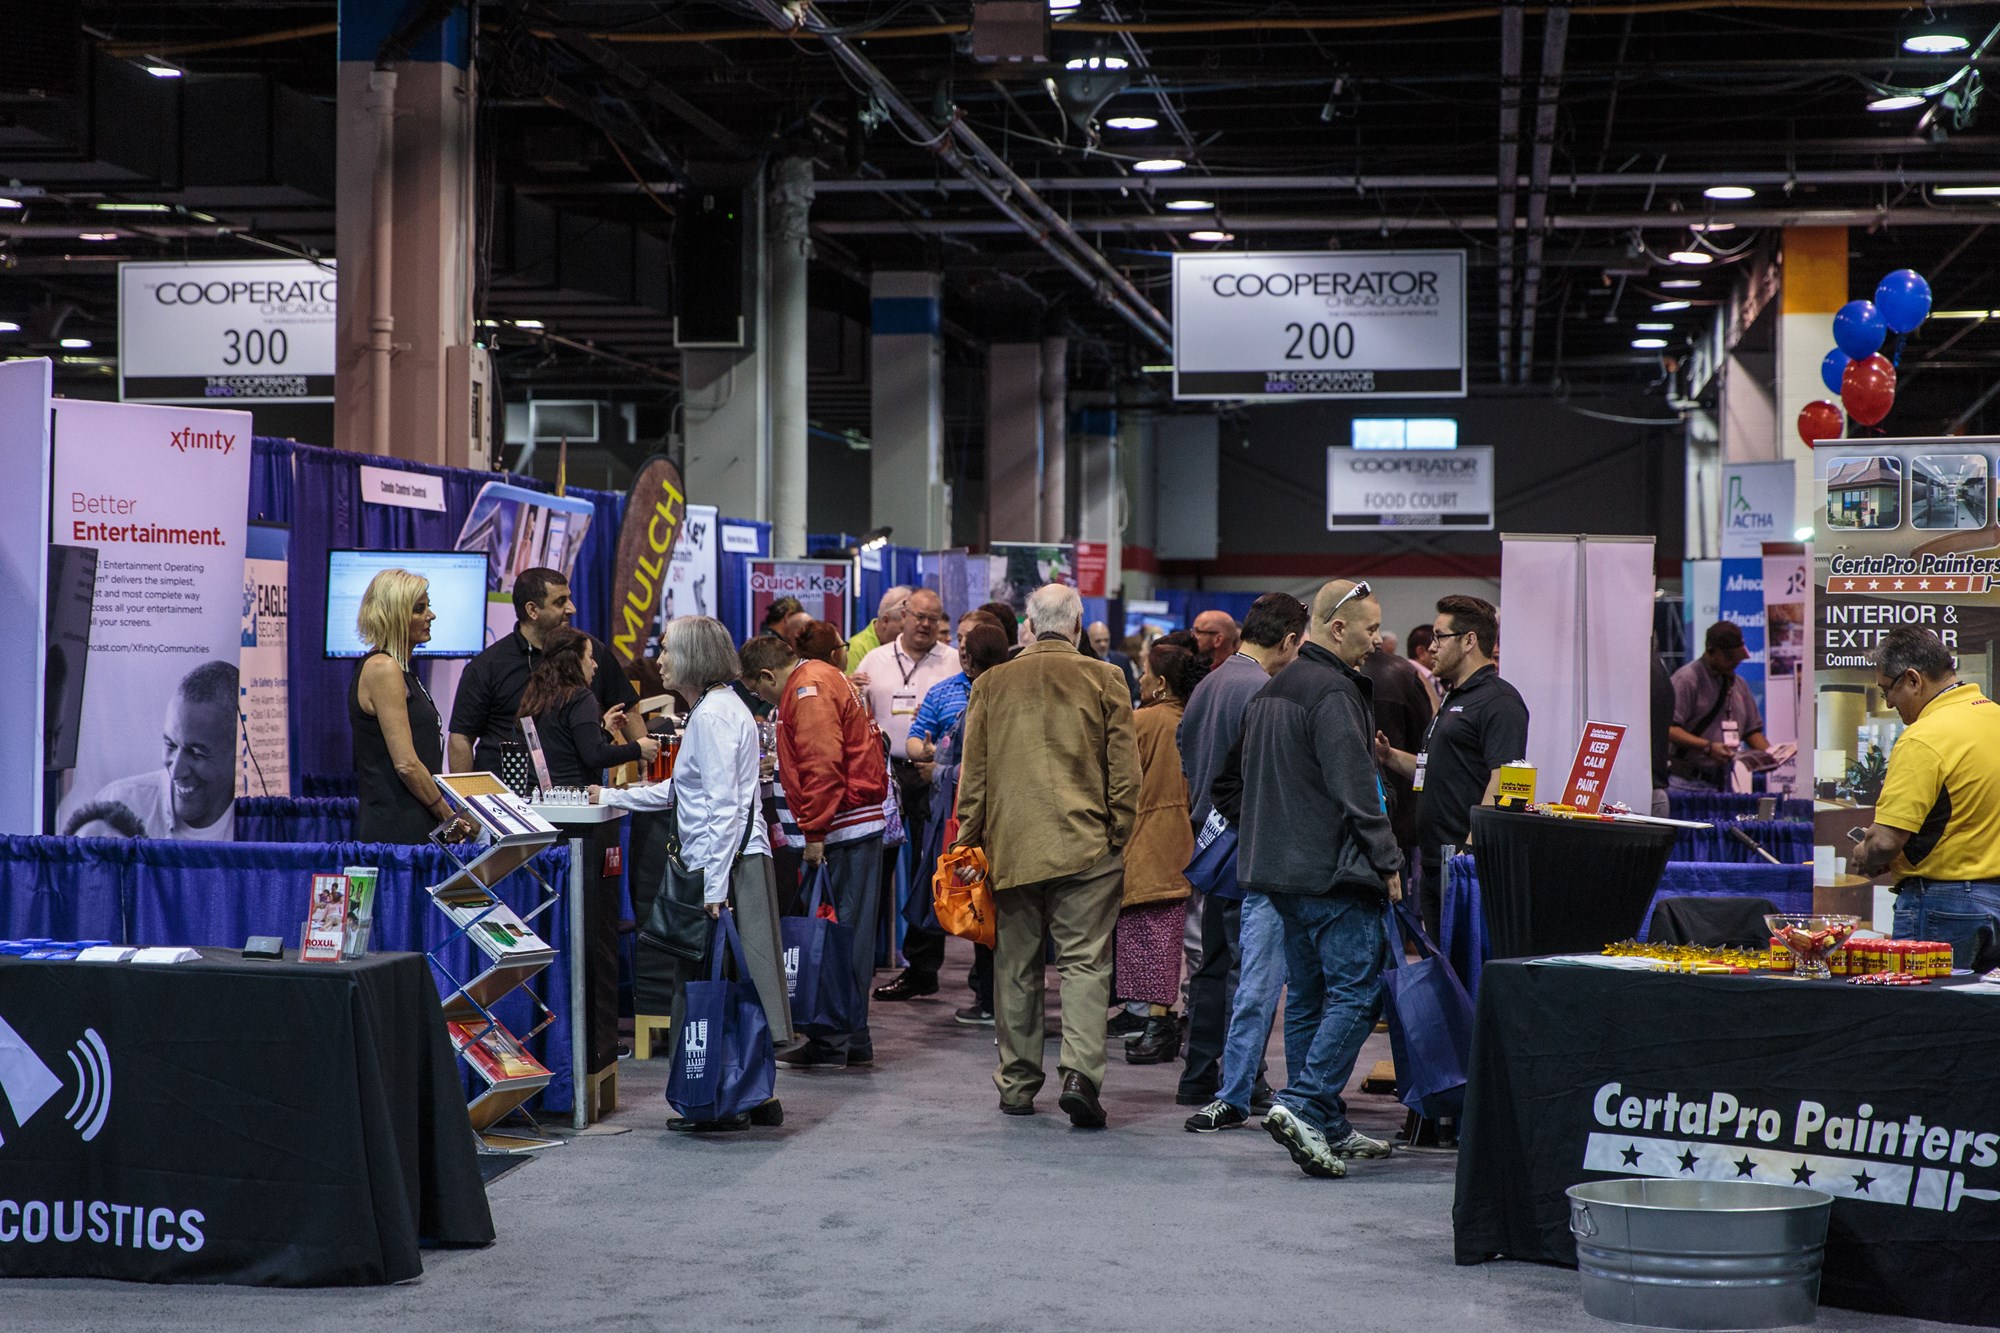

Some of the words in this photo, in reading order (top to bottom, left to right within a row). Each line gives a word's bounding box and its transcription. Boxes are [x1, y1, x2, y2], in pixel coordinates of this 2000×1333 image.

[1213, 271, 1438, 297] COOPERATOR
[1325, 295, 1440, 307] CHICAGOLAND
[223, 328, 287, 365] 300
[1285, 322, 1354, 360] 200
[205, 377, 227, 387] THE
[229, 376, 306, 387] COOPERATOR
[1267, 371, 1289, 381] THE
[1291, 371, 1374, 381] COOPERATOR
[1265, 382, 1295, 392] EXPO
[1296, 381, 1375, 392] CHICAGOLAND
[170, 427, 236, 455] xfinity
[1351, 457, 1478, 474] COOPERATOR
[72, 492, 137, 515] Better
[1364, 491, 1406, 509] FOOD
[1410, 491, 1459, 509] COURT
[1734, 513, 1773, 528] ACTHA
[73, 521, 226, 546] Entertainment.
[103, 560, 162, 571] Entertainment
[164, 562, 205, 574] Operating
[613, 480, 684, 661] MULCH
[1831, 554, 1918, 575] CertaPro
[111, 576, 143, 585] delivers
[144, 577, 158, 585] the
[160, 577, 196, 587] simplest,
[751, 574, 805, 590] Quick
[809, 574, 847, 595] Key
[104, 590, 120, 598] and
[122, 590, 143, 599] most
[144, 591, 182, 600] complete
[184, 593, 201, 601] way
[258, 584, 287, 617] EAGLE
[115, 604, 125, 612] all
[126, 605, 144, 613] your
[146, 605, 203, 614] entertainment
[1826, 605, 1937, 624] INTERIOR
[1943, 605, 1959, 624] &
[99, 619, 118, 627] your
[119, 619, 152, 627] screens.
[1825, 629, 1958, 648] EXTER
[1589, 741, 1610, 754] KEEP
[1583, 755, 1607, 769] CALM
[1575, 778, 1600, 793] PAINT
[1575, 794, 1590, 806] ON
[304, 939, 335, 947] ROXUL
[1593, 1082, 1781, 1142] CertaPro
[1794, 1099, 2000, 1168] Painters
[0, 1199, 206, 1252] COUSTICS
